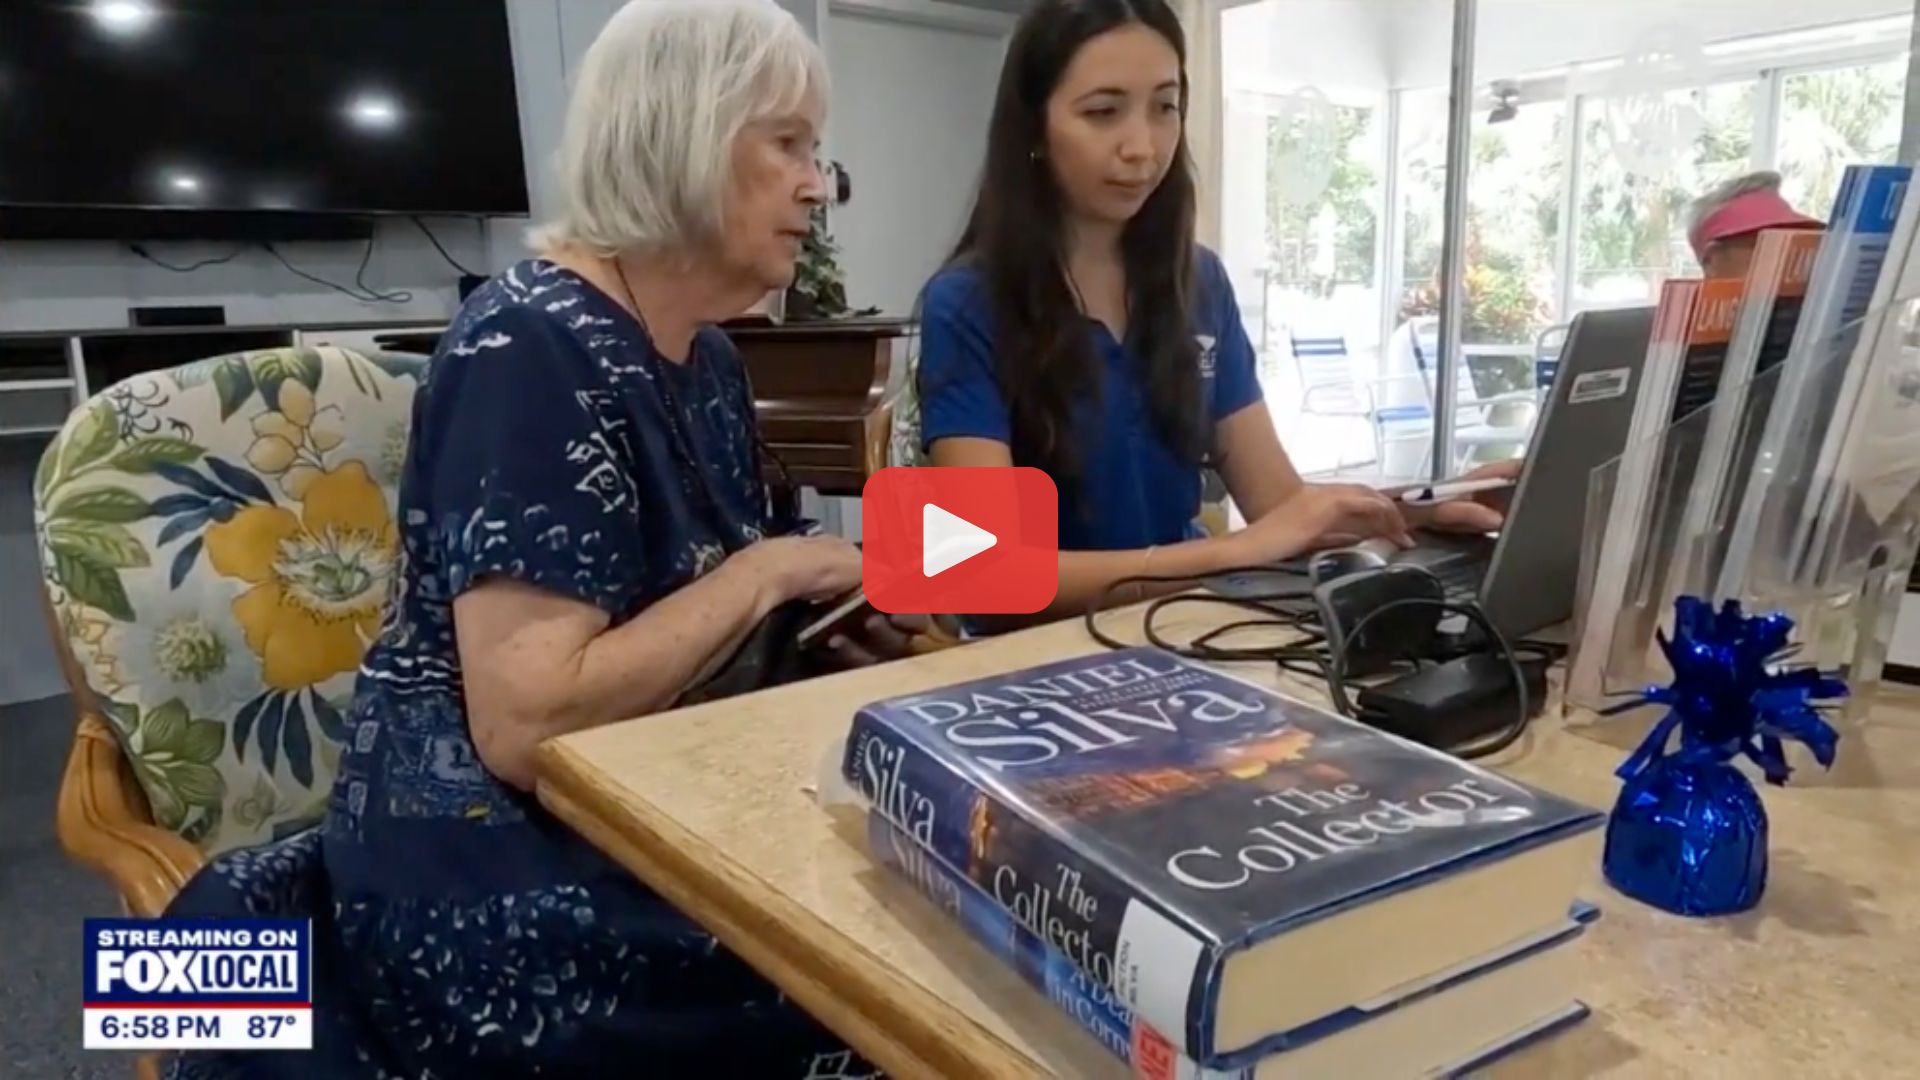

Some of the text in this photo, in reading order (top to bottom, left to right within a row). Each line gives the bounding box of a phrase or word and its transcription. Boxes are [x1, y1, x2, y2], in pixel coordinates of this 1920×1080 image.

[908, 659, 1185, 725] DANIEL
[945, 690, 1265, 772] Silva
[858, 737, 935, 850] Silva
[1166, 778, 1503, 889] Collector
[1253, 780, 1371, 817] The
[994, 864, 1116, 989] Collecto
[1056, 863, 1098, 922] The
